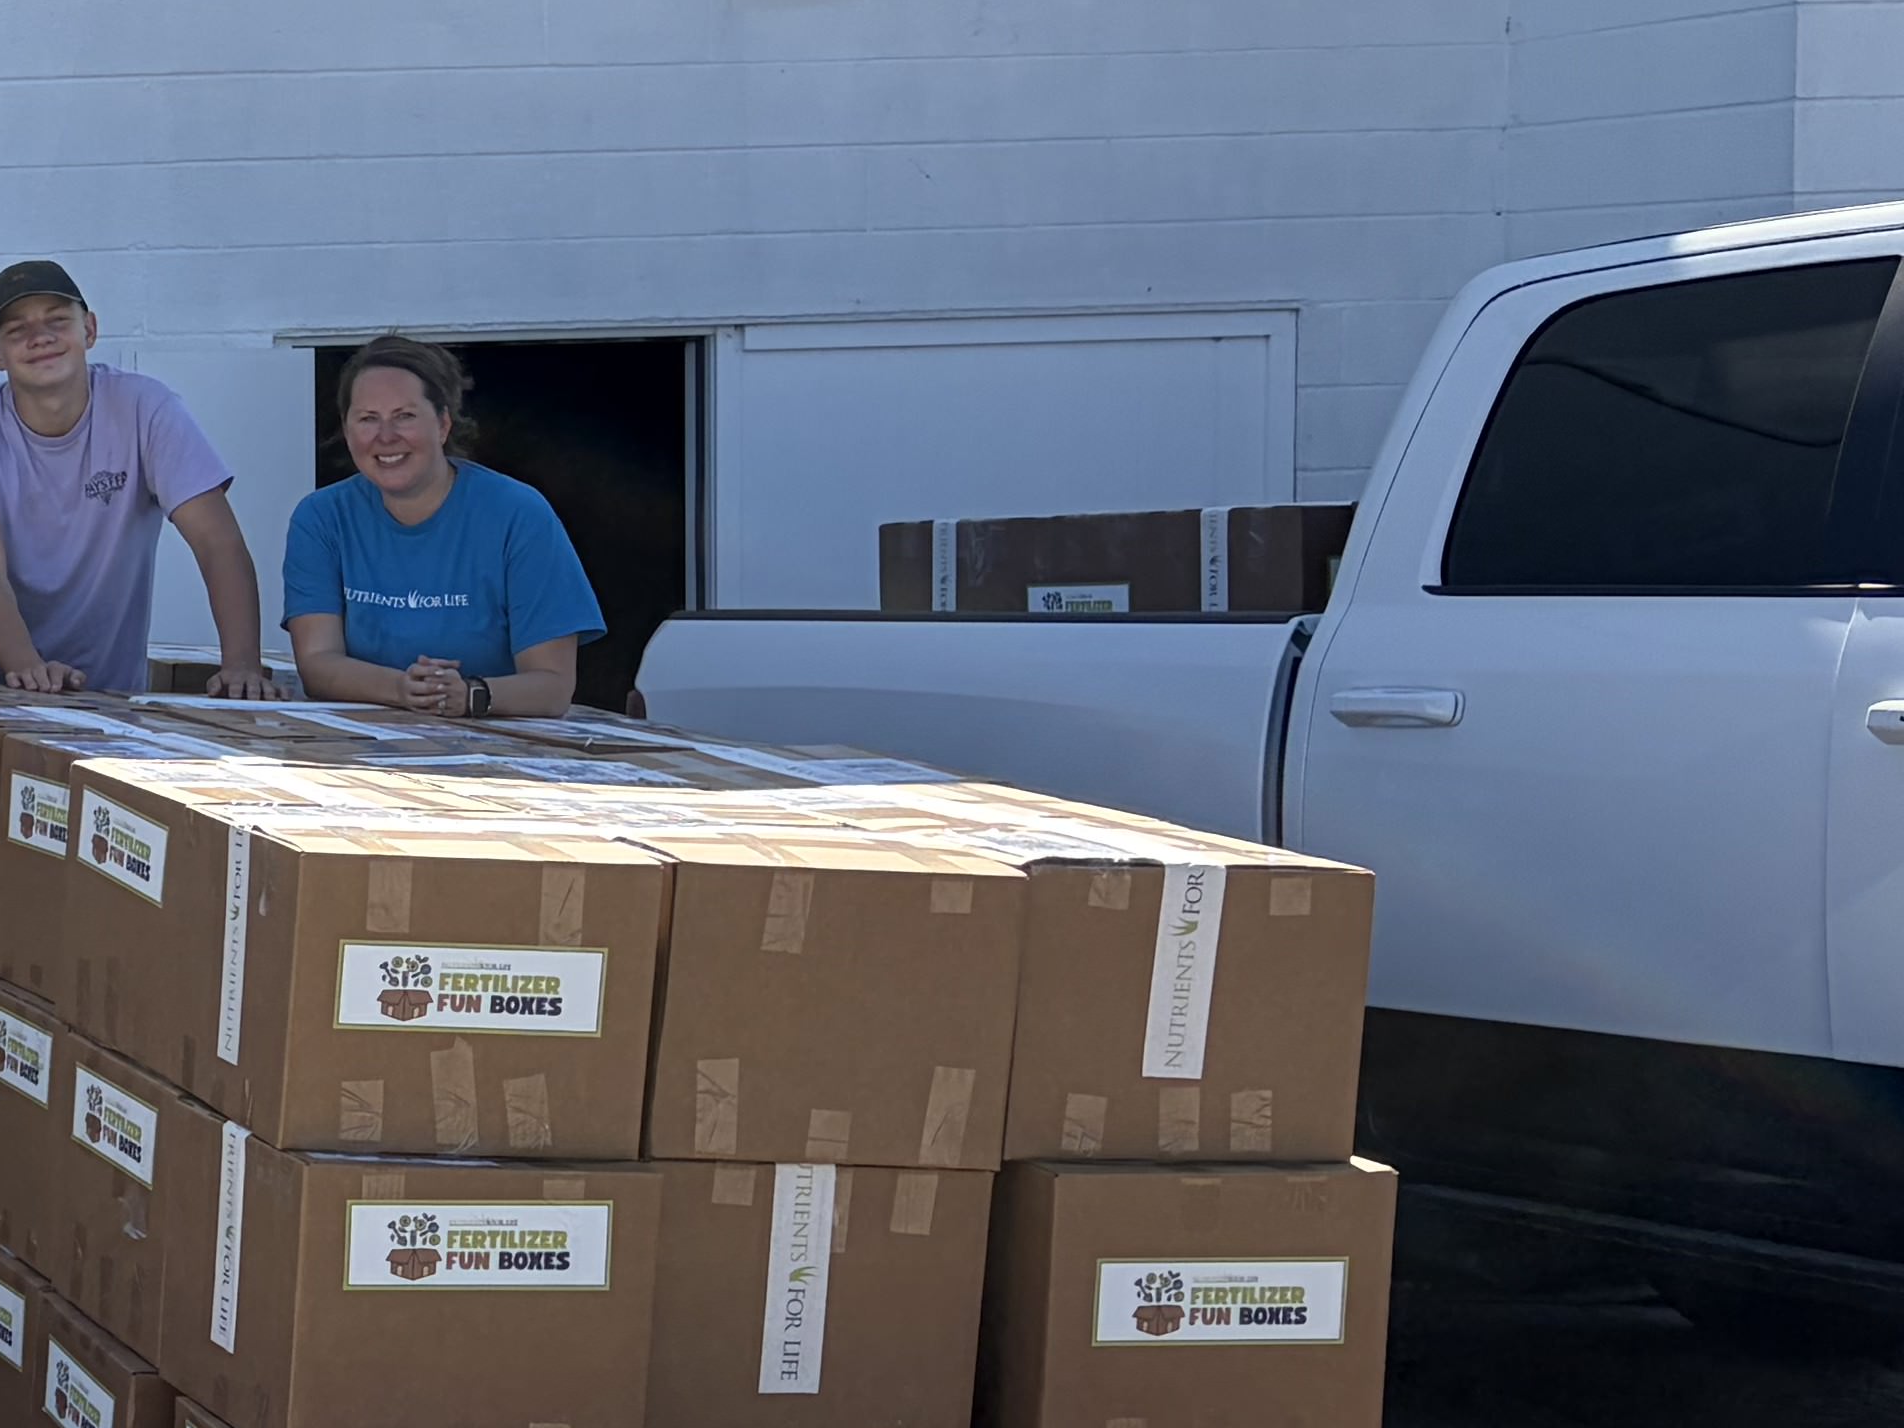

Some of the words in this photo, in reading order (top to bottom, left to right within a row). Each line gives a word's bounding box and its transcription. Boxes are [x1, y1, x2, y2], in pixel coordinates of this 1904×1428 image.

[418, 595, 442, 608] FOR
[443, 593, 470, 607] LIFE
[126, 854, 151, 882] BOXES
[1164, 939, 1197, 1069] NUTRIENTS
[1182, 870, 1205, 914] FOR
[439, 973, 560, 995] FERTILIZER
[437, 994, 482, 1013] FUN
[490, 995, 563, 1016] BOXES
[791, 1164, 814, 1262] UTRIENTS
[447, 1230, 568, 1249] FERTILIZER
[445, 1251, 490, 1270] FUN
[498, 1251, 570, 1270] BOXES
[1190, 1286, 1305, 1305] FERTILIZER
[784, 1288, 806, 1332] FOR
[1189, 1307, 1231, 1326] FUN
[1239, 1306, 1308, 1325] BOXES
[781, 1340, 801, 1381] LIFE
